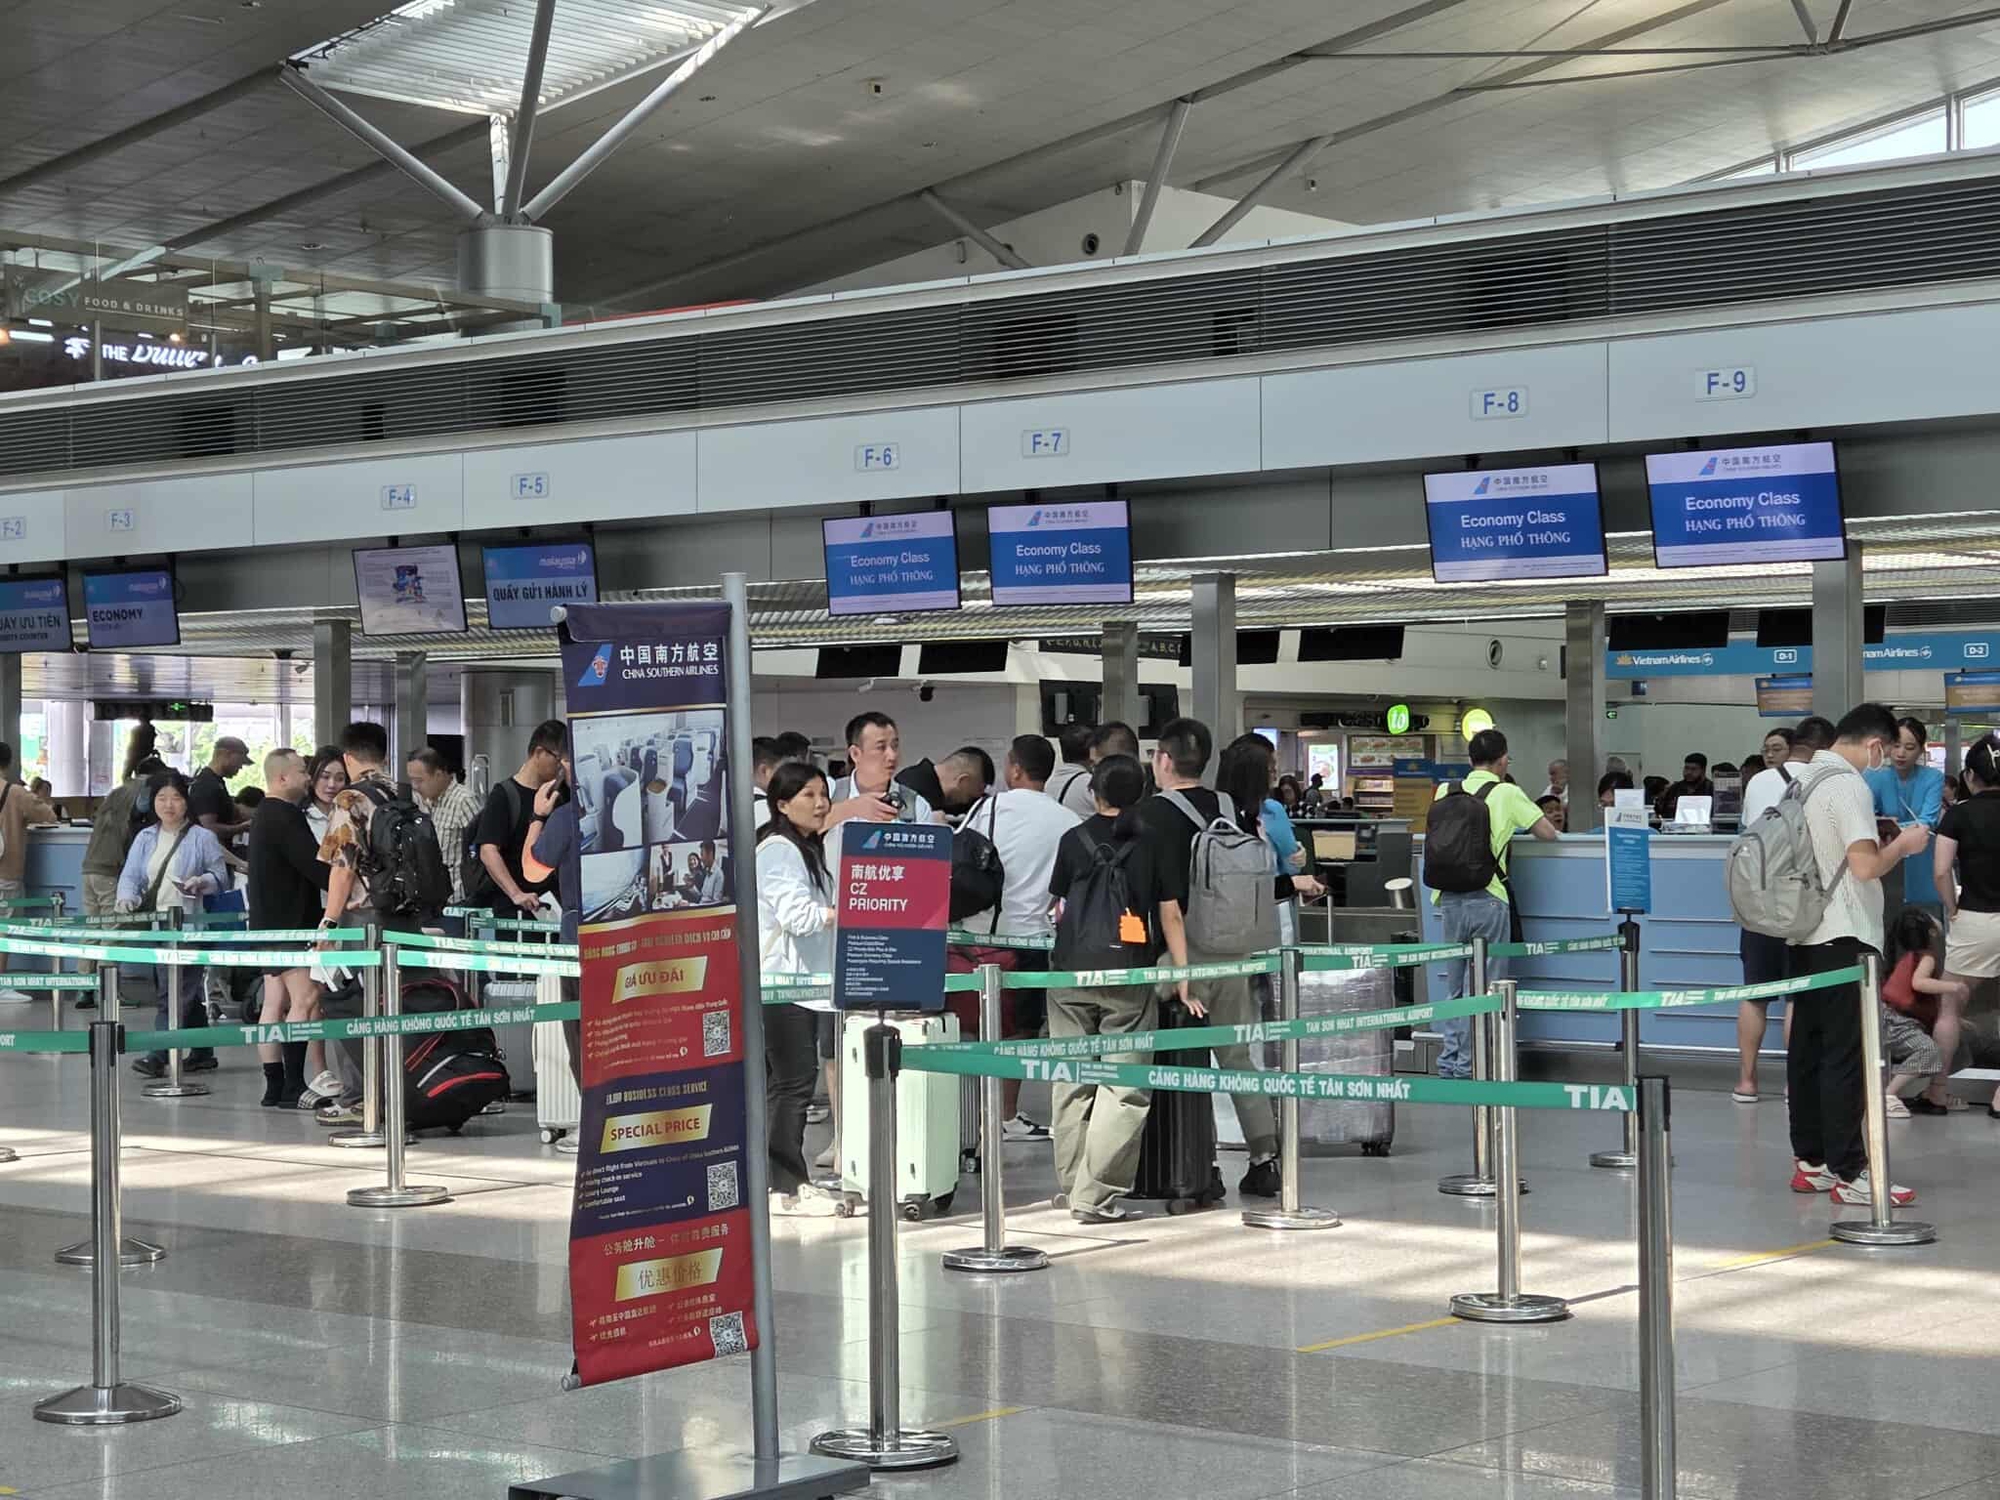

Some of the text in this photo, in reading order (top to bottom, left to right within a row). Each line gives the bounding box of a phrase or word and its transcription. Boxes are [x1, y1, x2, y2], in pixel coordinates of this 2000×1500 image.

[84, 297, 119, 307] FOOD
[136, 304, 185, 317] DRINKS
[102, 344, 129, 362] THE
[1706, 371, 1746, 395] F-9
[1482, 391, 1520, 415] F-8
[1031, 433, 1062, 454] F-7
[864, 447, 893, 467] F-6
[519, 477, 543, 495] F-5
[389, 489, 412, 506] F-4
[1685, 492, 1800, 511] Economy Class
[111, 512, 131, 528] F-3
[1461, 510, 1565, 528] Economy Class
[1685, 519, 1722, 535] HẠNG
[1758, 513, 1806, 528] THÔNG
[3, 520, 22, 537] F-2
[1016, 541, 1101, 557] Economy Class
[1461, 536, 1494, 551] HẠNG
[1527, 530, 1571, 545] THÔNG
[850, 551, 930, 568] Economy Class
[92, 608, 143, 622] ECONOMY
[619, 641, 719, 666] 中国南方航空
[622, 664, 719, 680] CHINA SOUTHERN AIRLINES
[851, 864, 905, 881] 南航优享
[850, 882, 868, 896] CZ
[848, 898, 908, 912] PRIORITY
[1352, 955, 1373, 969] TIA
[1075, 970, 1104, 986] TIA
[374, 1020, 399, 1034] HÀNG
[401, 1017, 432, 1031] KHÔNG
[434, 1012, 458, 1028] QUỐC
[459, 1011, 474, 1026] TẾ
[473, 1012, 491, 1026] TÂN
[1234, 1024, 1267, 1042] TIA
[1355, 1012, 1406, 1029] INTERNATIONAL
[1407, 1007, 1434, 1022] AIRPORT
[240, 1026, 285, 1044] TIA
[1021, 1059, 1073, 1082] TIA
[1183, 1070, 1216, 1089] HÀNG
[1219, 1073, 1260, 1093] KHÔNG
[1263, 1073, 1296, 1095] QUỐC
[1299, 1074, 1316, 1095] TẾ
[1319, 1078, 1344, 1097] TÂN
[1347, 1079, 1373, 1098] SƠN
[1376, 1077, 1412, 1100] NHẤT
[624, 1087, 657, 1103] BUSINESS
[1564, 1085, 1629, 1111] TIA
[610, 1117, 701, 1142] SPECIAL PRICE
